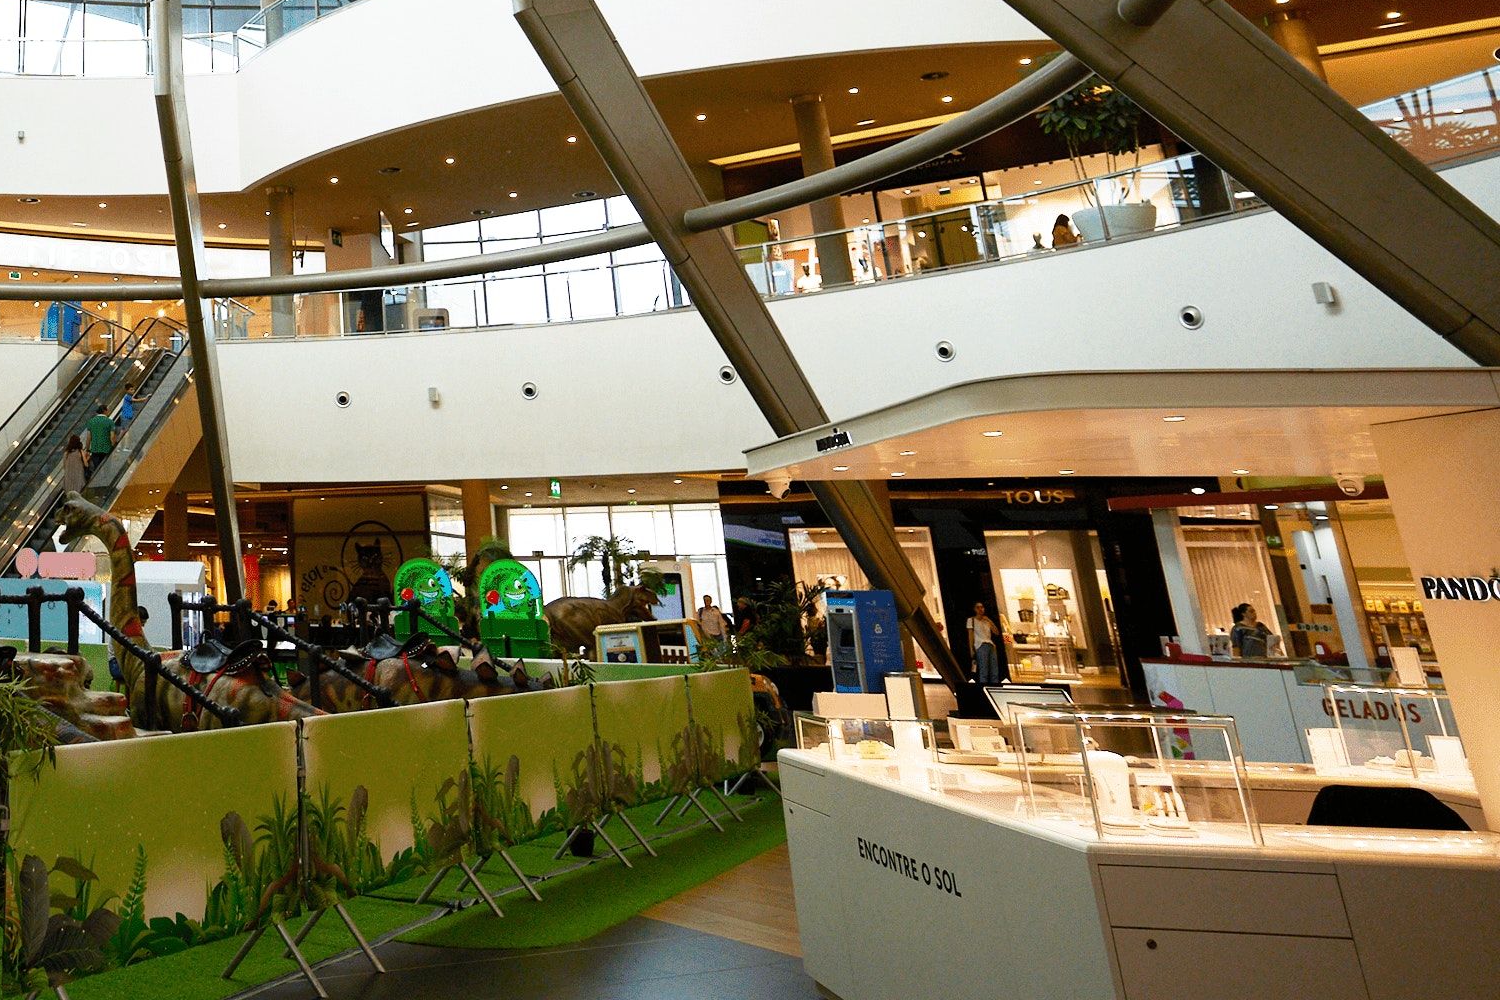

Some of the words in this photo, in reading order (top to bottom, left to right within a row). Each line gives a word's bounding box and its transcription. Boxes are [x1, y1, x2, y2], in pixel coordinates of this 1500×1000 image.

[23, 241, 168, 272] TIFFOSI
[1001, 490, 1066, 504] TOUS
[1322, 698, 1422, 723] GELADOS
[857, 837, 919, 881] ENCONTRE
[921, 862, 931, 886] O
[934, 867, 962, 897] SOL
